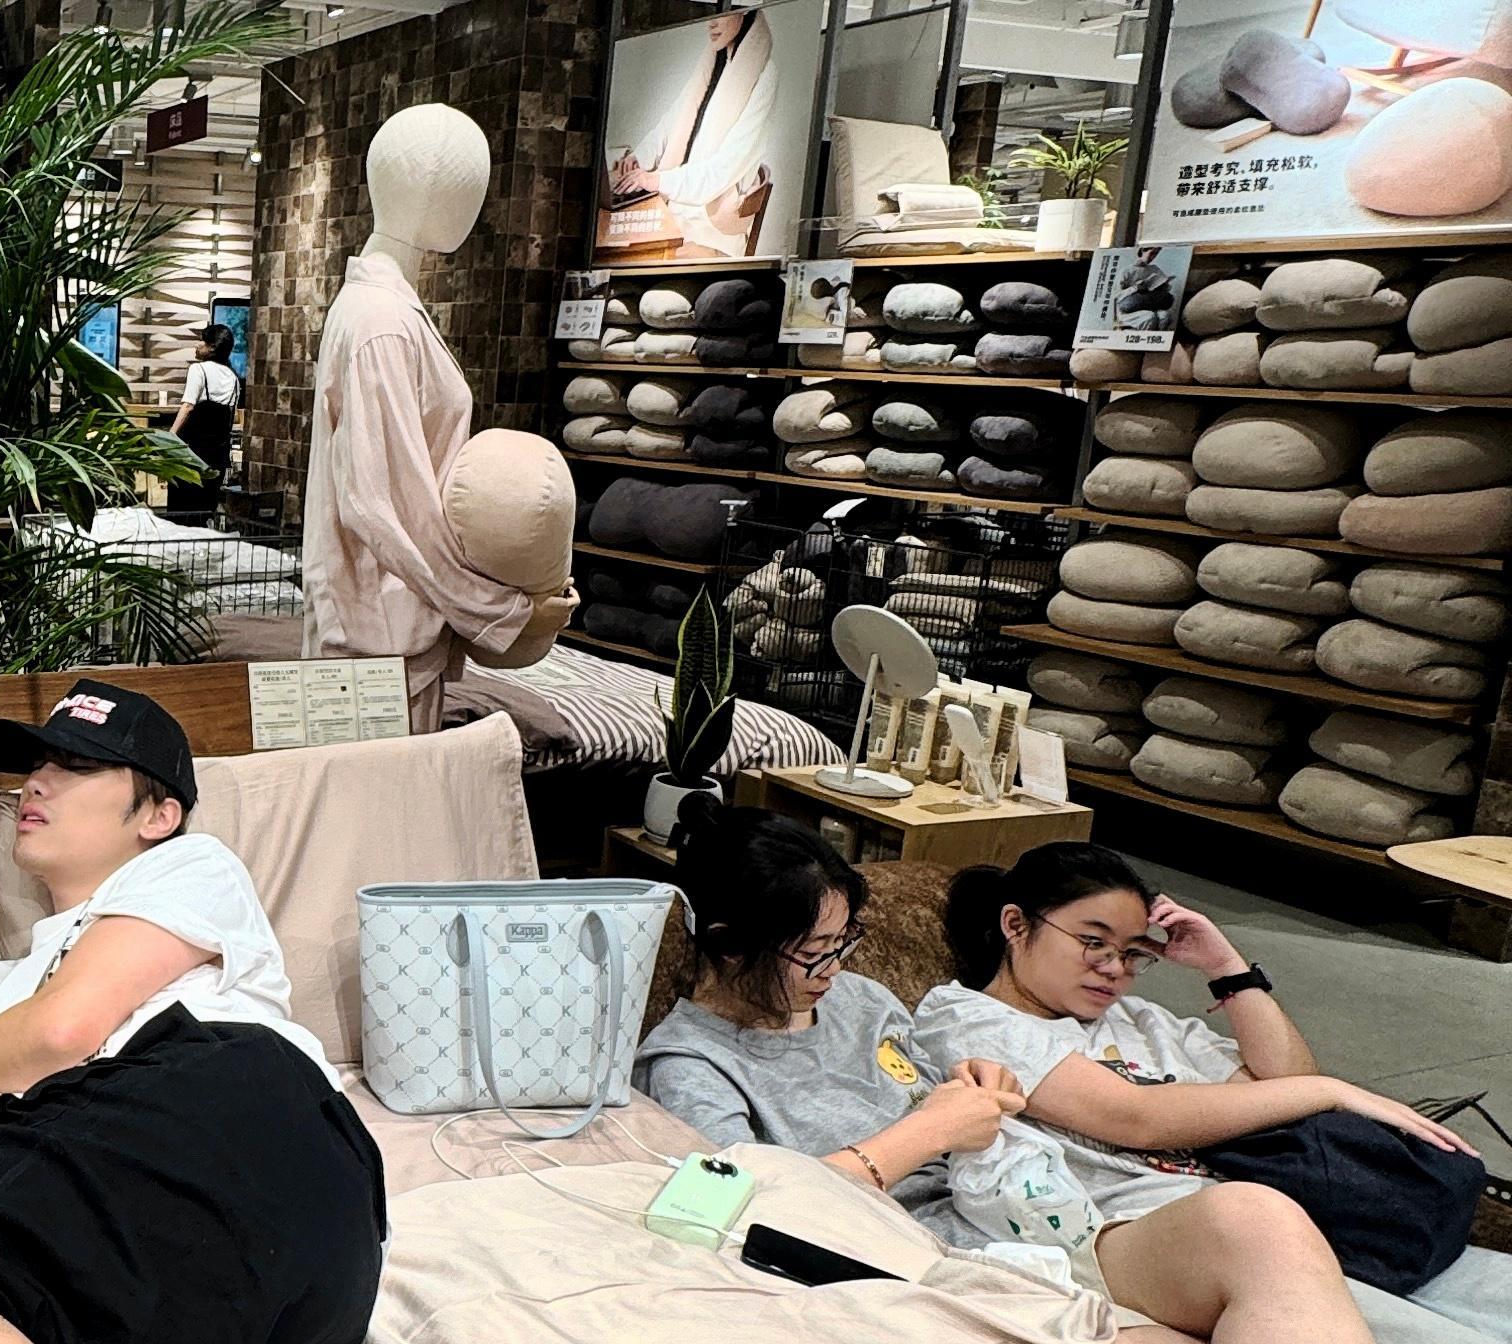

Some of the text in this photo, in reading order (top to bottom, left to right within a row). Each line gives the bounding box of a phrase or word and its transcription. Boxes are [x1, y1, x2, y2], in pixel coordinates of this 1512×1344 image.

[400, 924, 409, 935] K
[440, 924, 449, 935] K
[511, 925, 544, 938] Kappa
[558, 923, 568, 934] K
[638, 921, 647, 932] K
[398, 965, 408, 976] K
[440, 965, 450, 977] K
[520, 965, 530, 977] K
[560, 964, 569, 975] K
[599, 963, 608, 975] K
[397, 1004, 407, 1015] K
[439, 1007, 450, 1018] K
[521, 1006, 531, 1018] K
[561, 1006, 571, 1017] K
[600, 1004, 608, 1015] K
[396, 1042, 404, 1053] K
[438, 1046, 448, 1058] K
[521, 1047, 531, 1058] K
[561, 1045, 570, 1057] K
[598, 1043, 605, 1053] K
[394, 1079, 405, 1091] K
[559, 1085, 568, 1096] K
[437, 1086, 447, 1097] K
[478, 1087, 488, 1098] K
[519, 1087, 529, 1097] K
